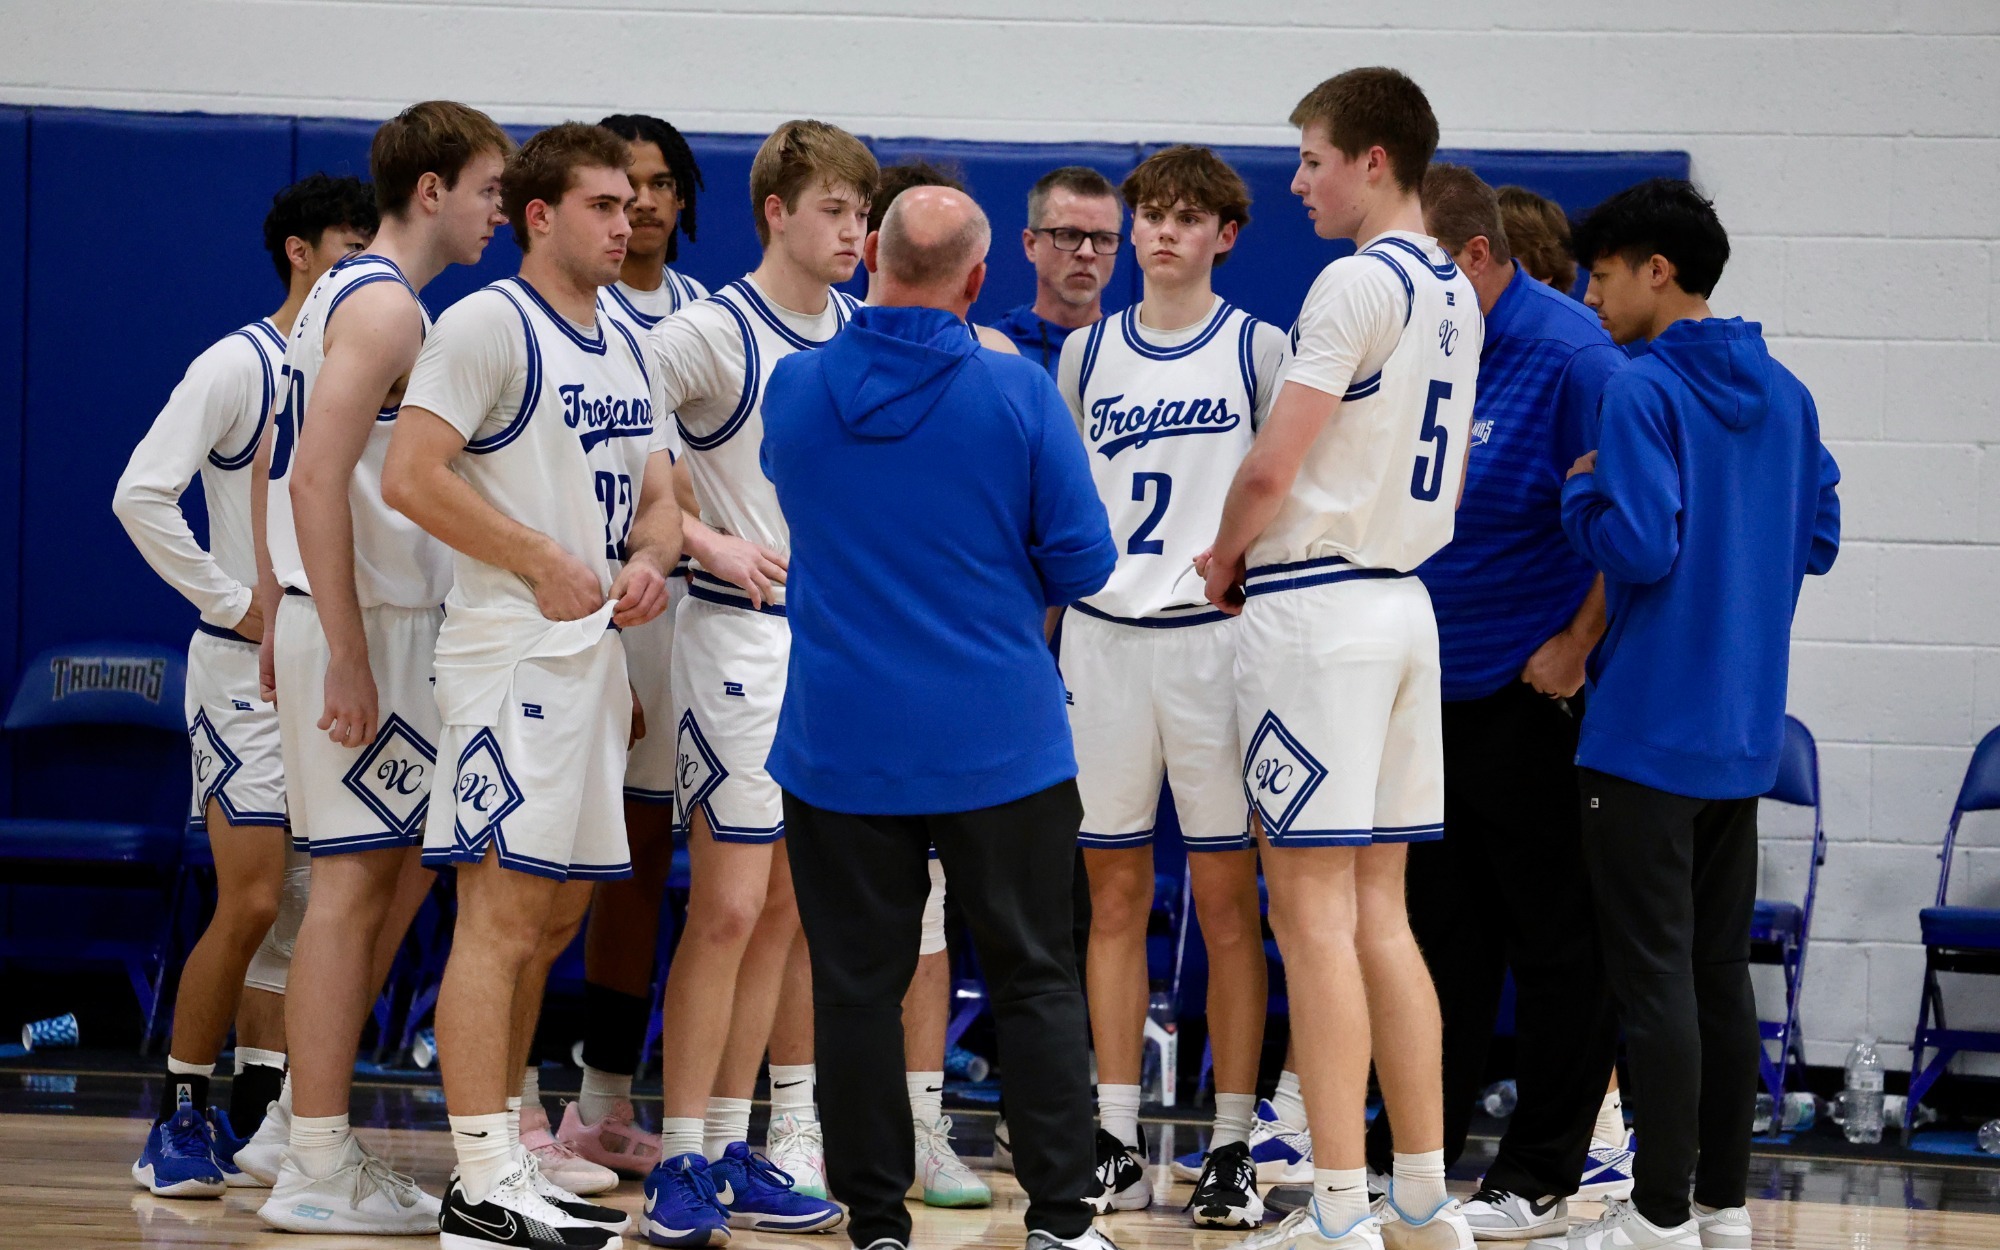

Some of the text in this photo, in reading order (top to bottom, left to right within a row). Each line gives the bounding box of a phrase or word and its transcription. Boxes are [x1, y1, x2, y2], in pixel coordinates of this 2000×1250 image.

[1090, 394, 1240, 455] Trojans
[1410, 379, 1453, 502] 5
[595, 471, 632, 560] 22
[1127, 472, 1173, 555] 2
[51, 656, 166, 704] TROJANS
[377, 758, 424, 795] VC
[1256, 758, 1293, 795] VC
[1725, 1210, 1744, 1220] NIKE
